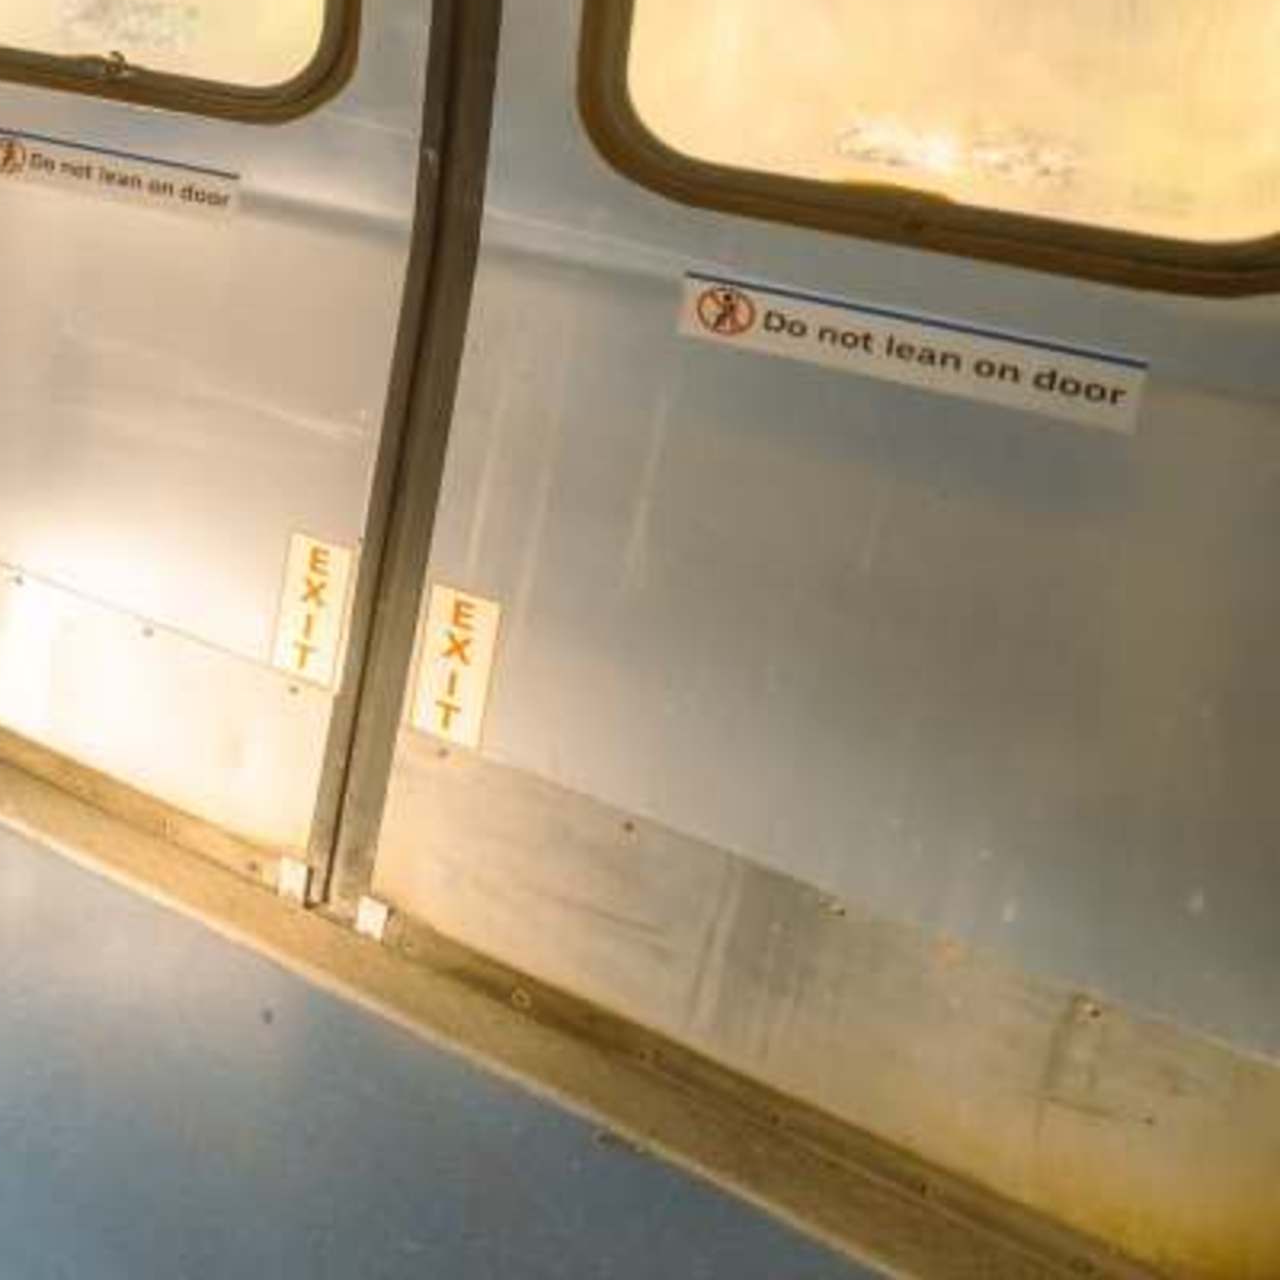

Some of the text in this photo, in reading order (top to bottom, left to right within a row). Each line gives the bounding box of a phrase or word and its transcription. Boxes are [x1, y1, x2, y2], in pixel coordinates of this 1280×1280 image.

[28, 151, 230, 207] Do not lean on door
[762, 309, 1129, 407] Do not lean on door
[293, 544, 330, 670] EXIT
[435, 599, 476, 730] EXIT
